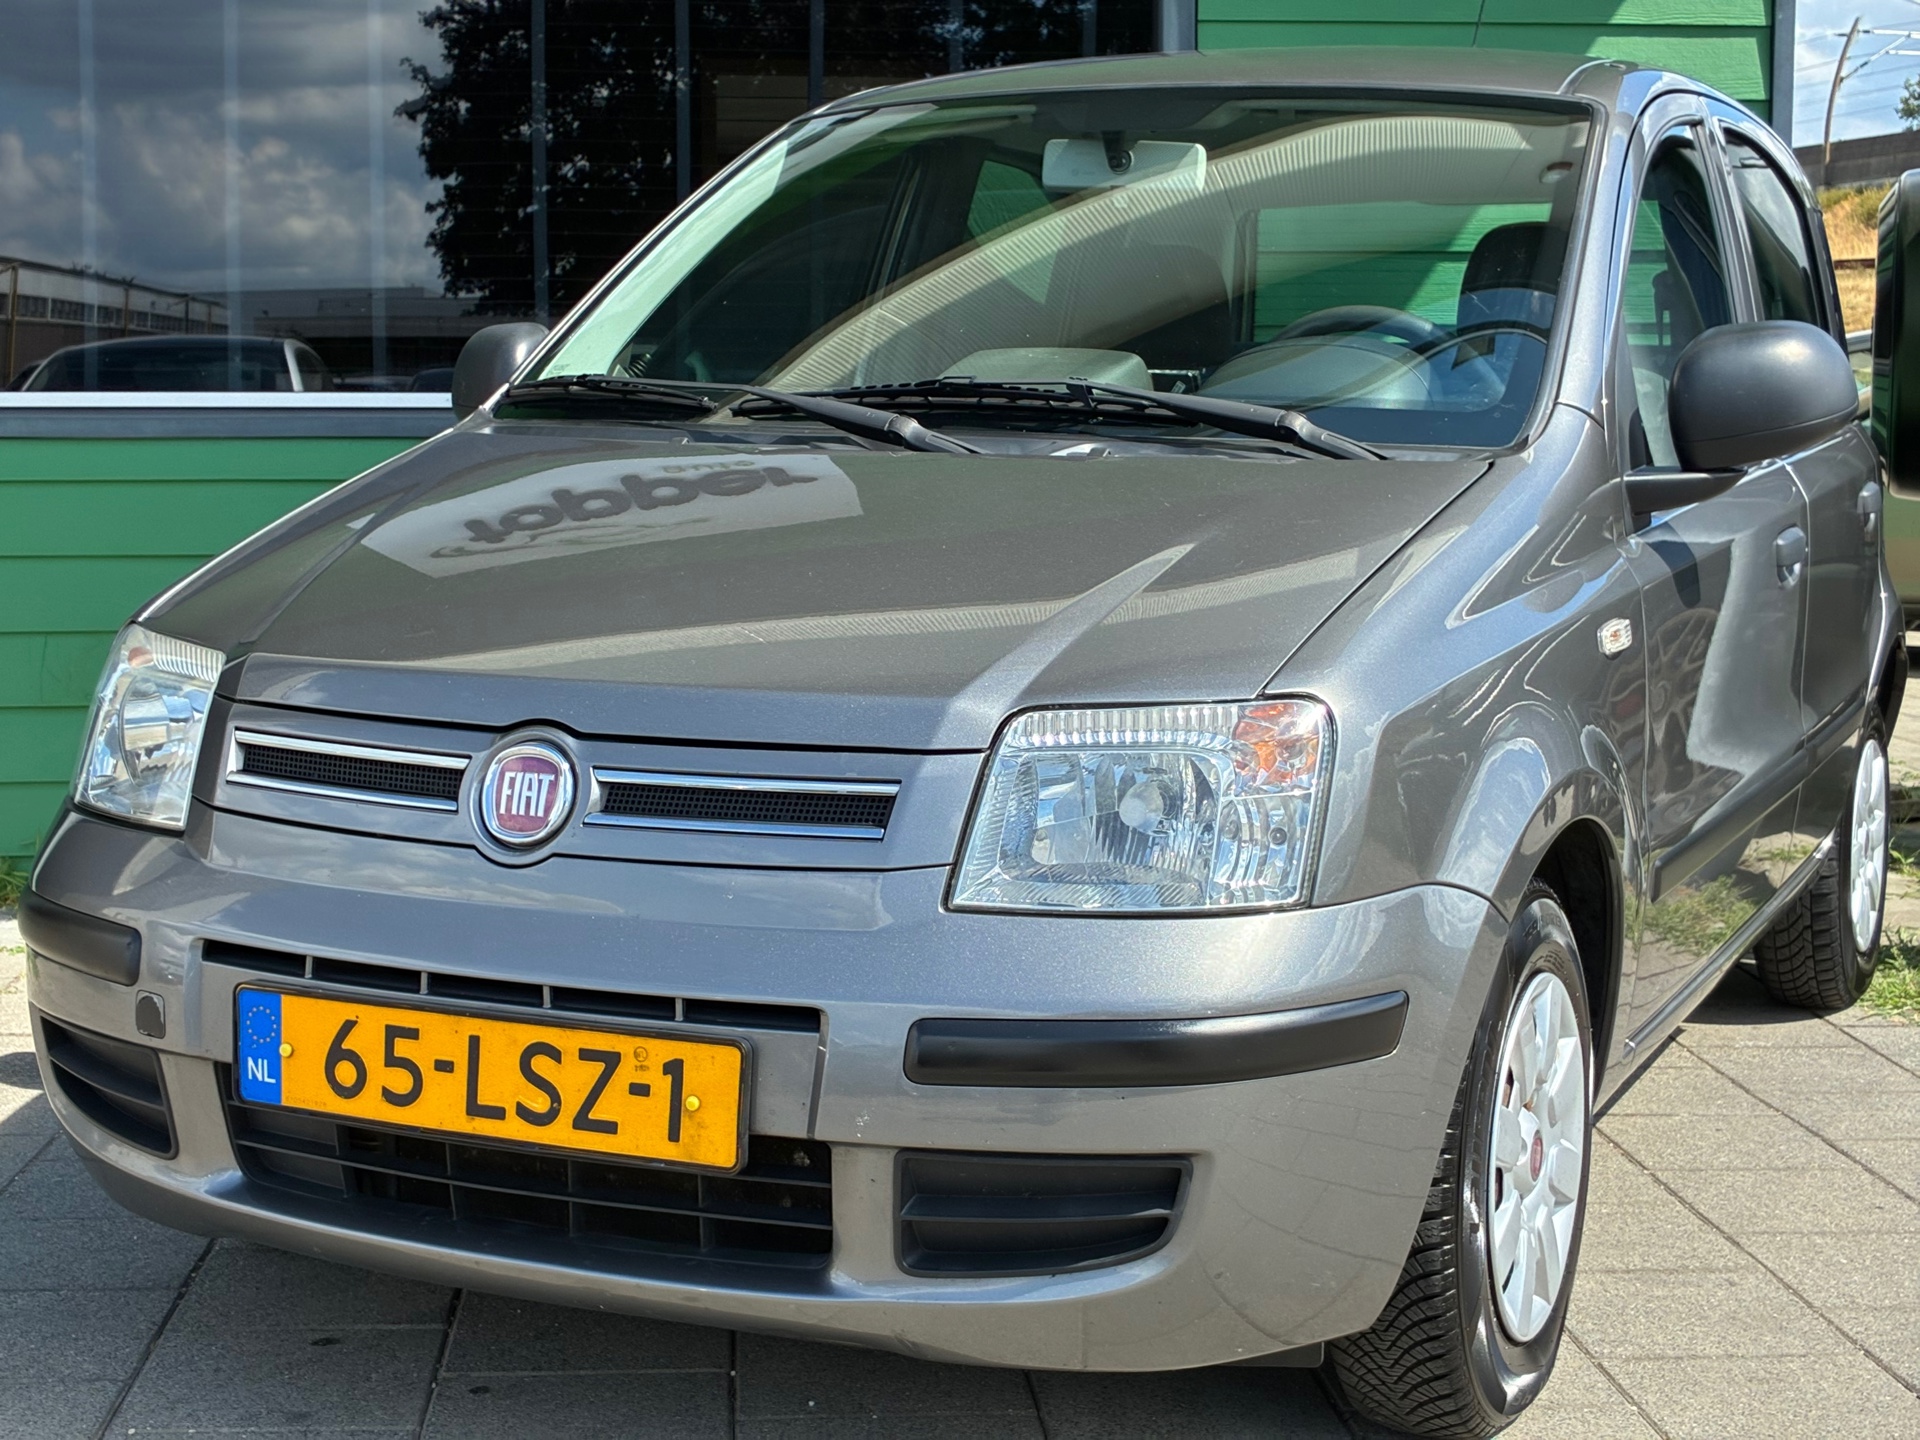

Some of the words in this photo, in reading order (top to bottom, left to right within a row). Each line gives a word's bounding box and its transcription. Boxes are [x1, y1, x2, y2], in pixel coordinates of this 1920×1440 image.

[499, 771, 555, 818] FIAT
[246, 1056, 277, 1085] NL
[323, 1019, 686, 1144] 65-LSZ-1
